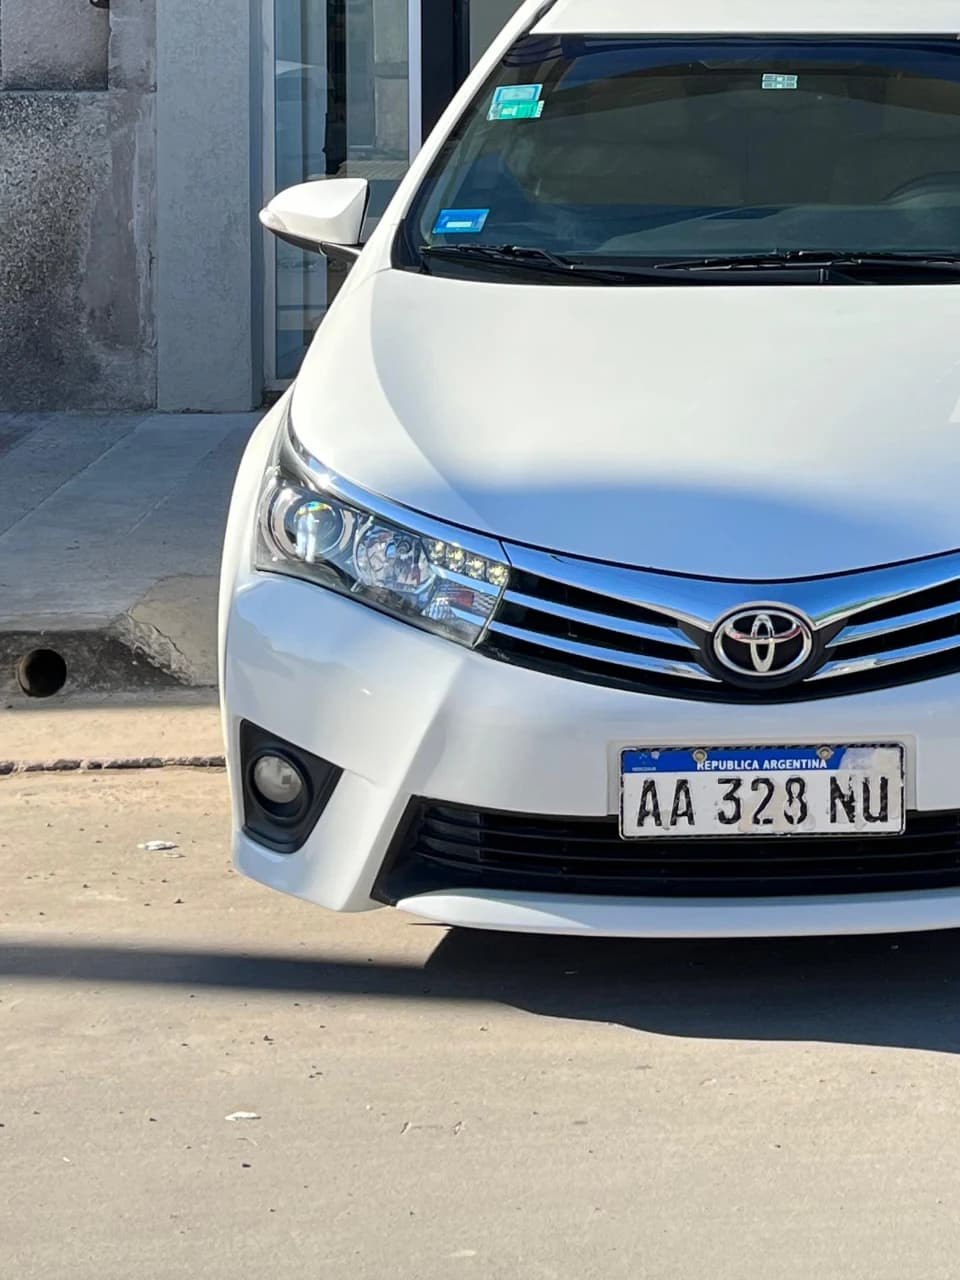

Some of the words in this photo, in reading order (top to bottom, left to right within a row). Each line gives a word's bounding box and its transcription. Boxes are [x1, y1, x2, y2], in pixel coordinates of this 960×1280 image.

[696, 759, 759, 771] REPUBLICA
[763, 759, 827, 770] ARGENTINA
[637, 779, 696, 827] AA
[717, 777, 808, 825] 328
[829, 776, 889, 824] NU
